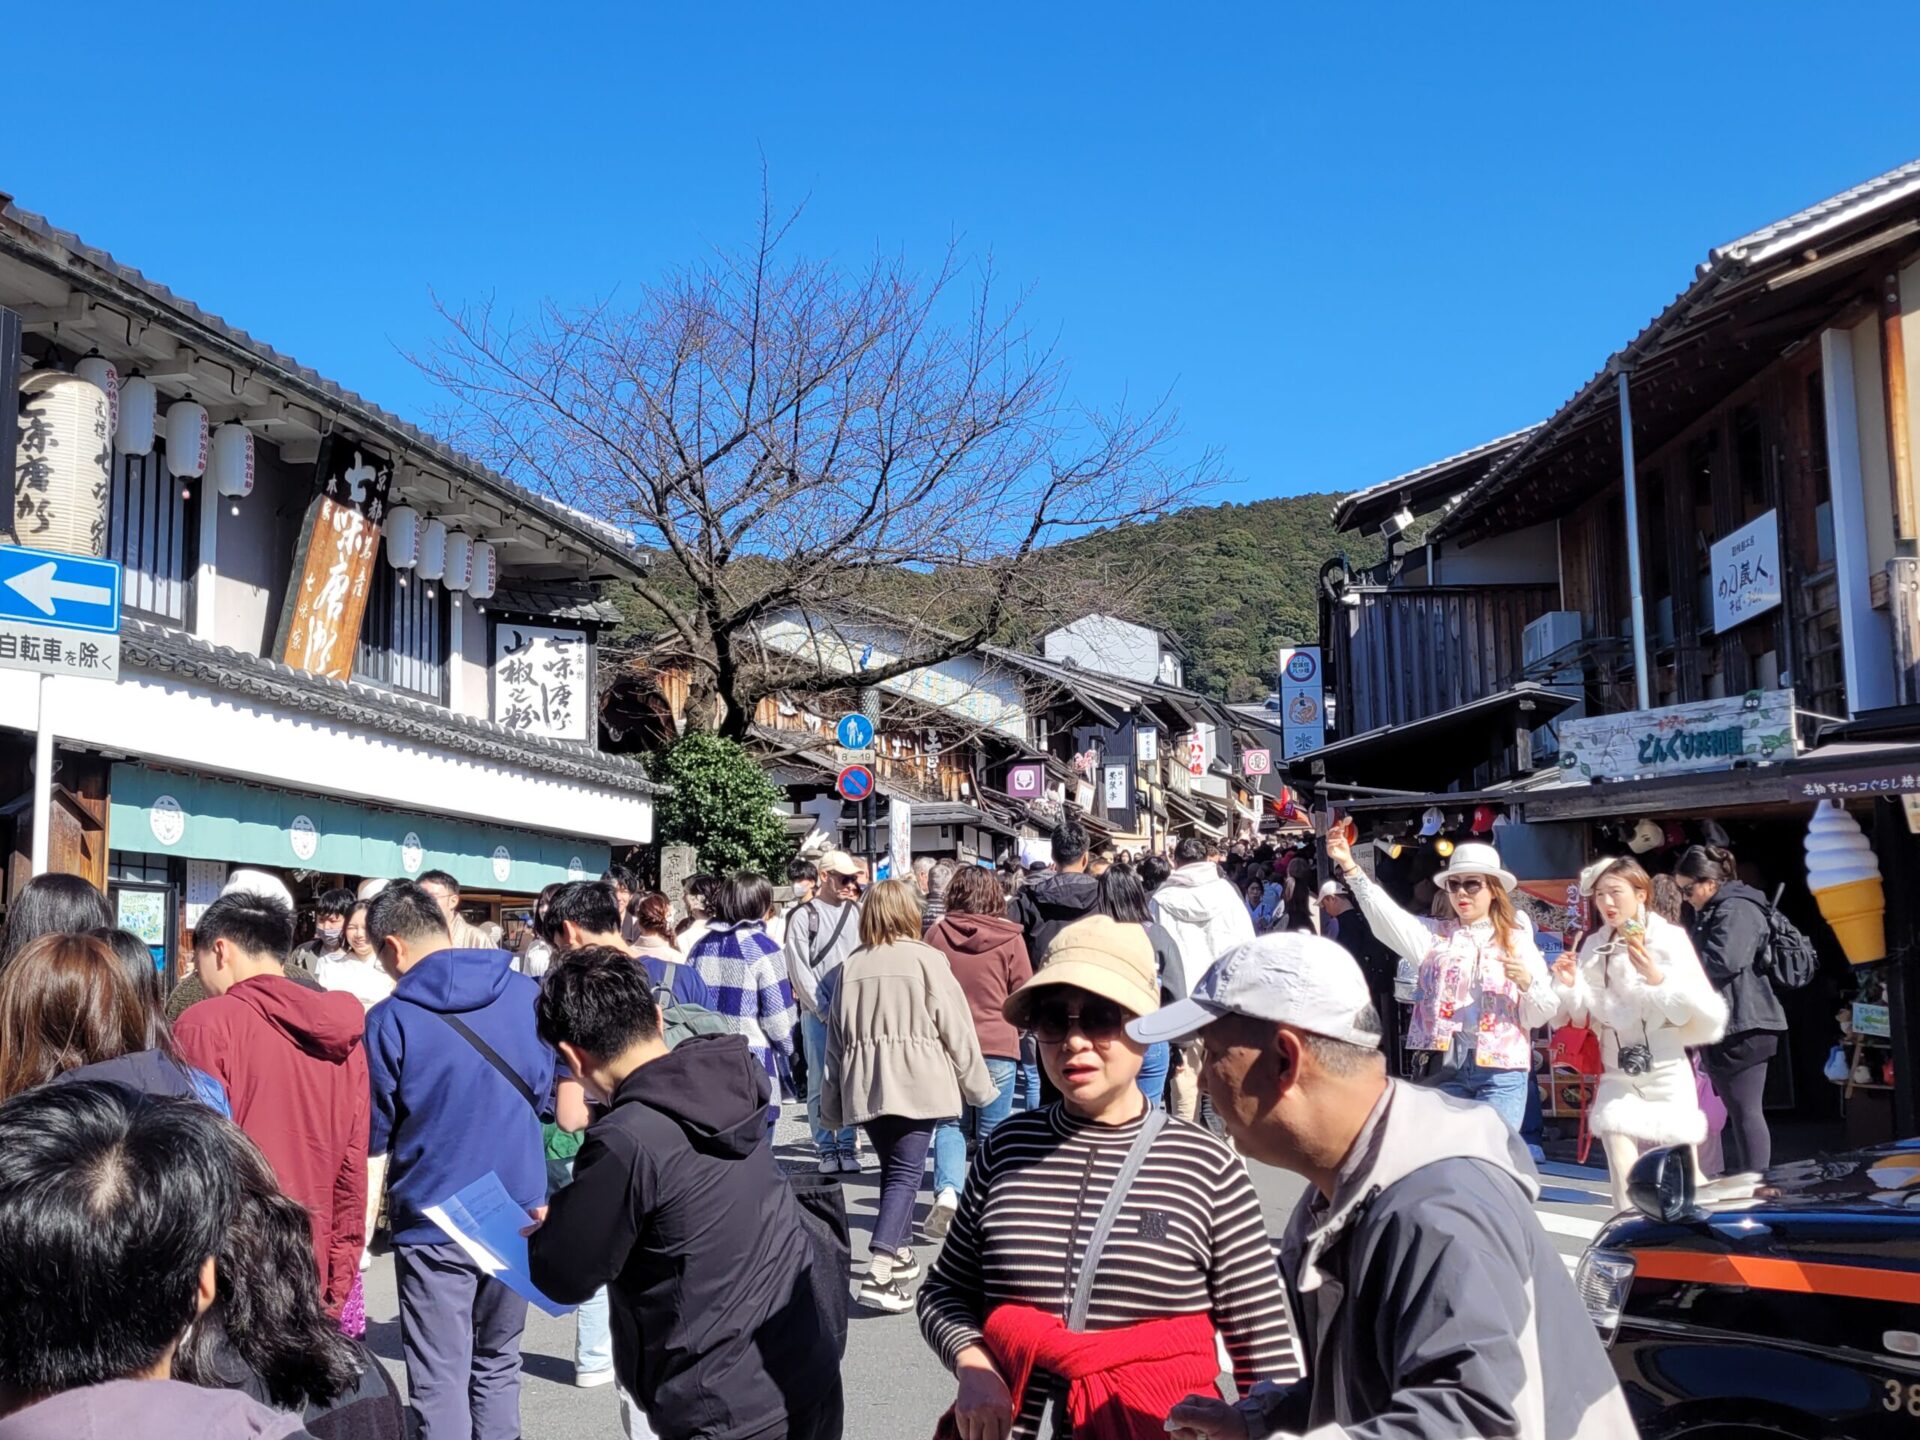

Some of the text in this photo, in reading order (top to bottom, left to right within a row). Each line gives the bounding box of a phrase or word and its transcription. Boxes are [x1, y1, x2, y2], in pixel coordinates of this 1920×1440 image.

[0, 632, 112, 671] 自転車を除く
[1638, 725, 1744, 764] どんぐり共和国
[1882, 1379, 1920, 1417] 38
